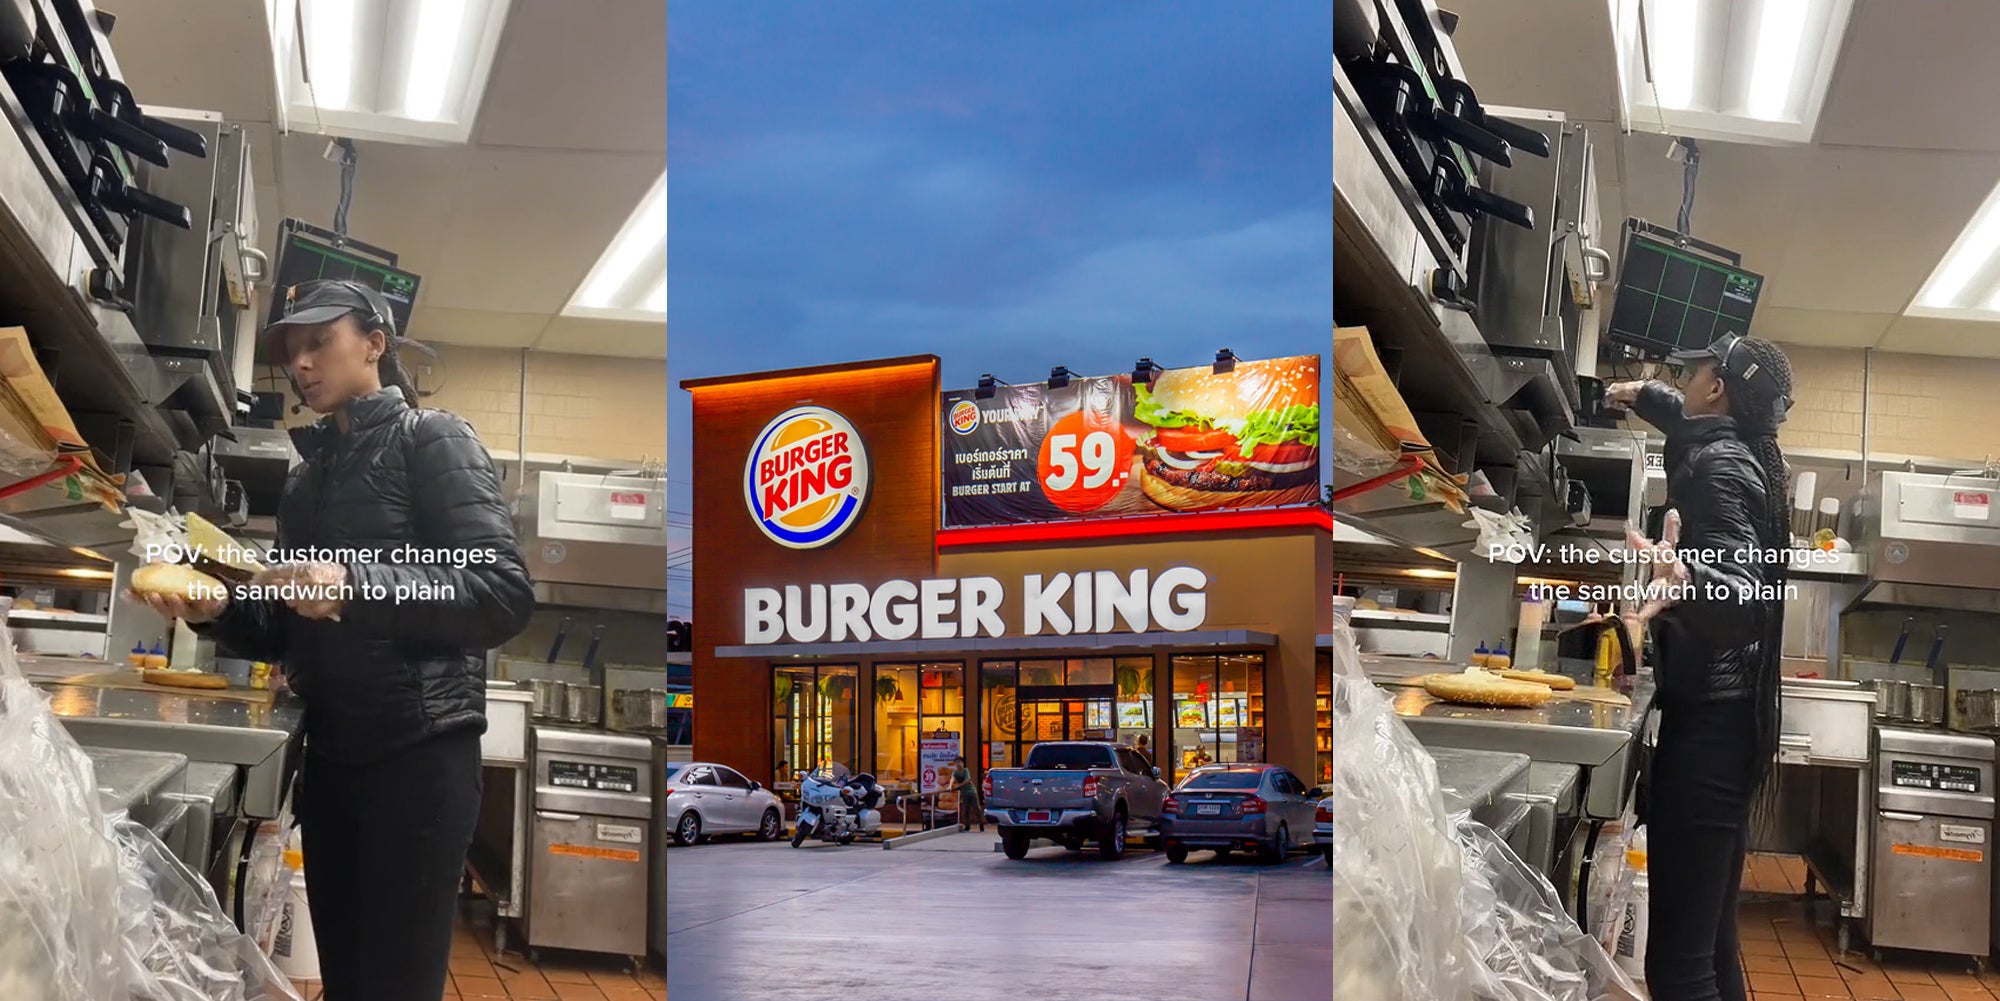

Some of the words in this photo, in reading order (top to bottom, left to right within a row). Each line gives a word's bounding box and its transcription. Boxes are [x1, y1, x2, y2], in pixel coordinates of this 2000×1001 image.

[953, 406, 975, 419] BURGER
[954, 412, 977, 428] KING
[982, 408, 1013, 423] YOUR
[761, 432, 848, 486] BURGER
[955, 446, 1028, 464] เบอร์เกอร์ราคา
[765, 455, 852, 520] KING
[952, 484, 989, 497] BURGER
[991, 482, 1017, 494] START
[1020, 481, 1031, 492] AT
[744, 576, 1006, 645] BURGER
[1023, 566, 1208, 635] KING
